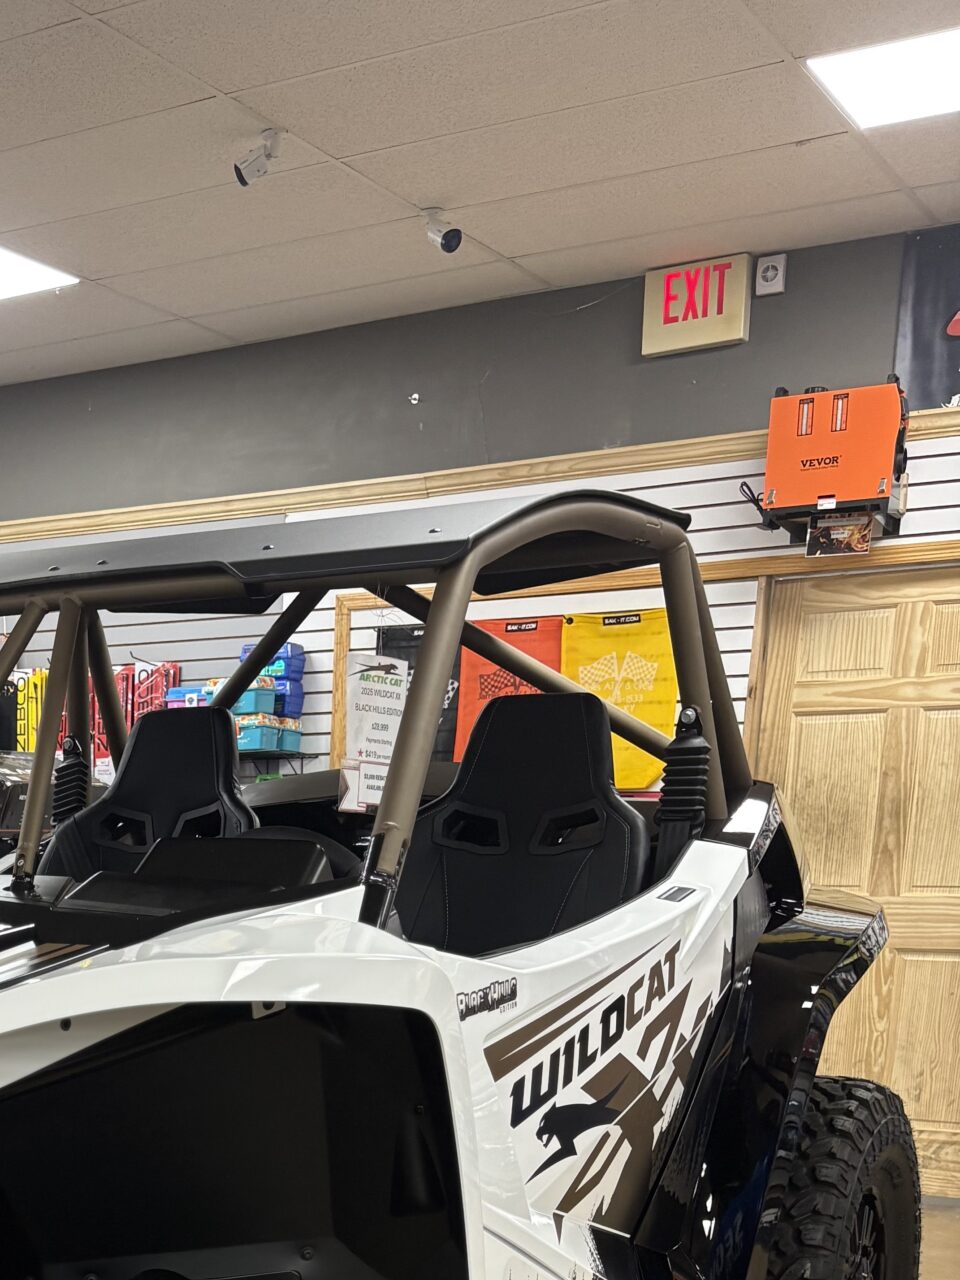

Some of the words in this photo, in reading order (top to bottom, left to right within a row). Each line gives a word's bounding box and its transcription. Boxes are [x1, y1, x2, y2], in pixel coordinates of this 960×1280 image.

[662, 262, 732, 325] EXIT
[801, 456, 839, 468] VEVOR
[359, 673, 389, 685] ARCTIC
[389, 678, 404, 687] CAT
[374, 689, 395, 699] WILDCAT
[16, 676, 26, 752] ZEBCO
[355, 702, 371, 712] BLACK
[372, 705, 386, 714] HILLS
[499, 1001, 517, 1013] EDITION
[509, 938, 682, 1129] WILDCAT
